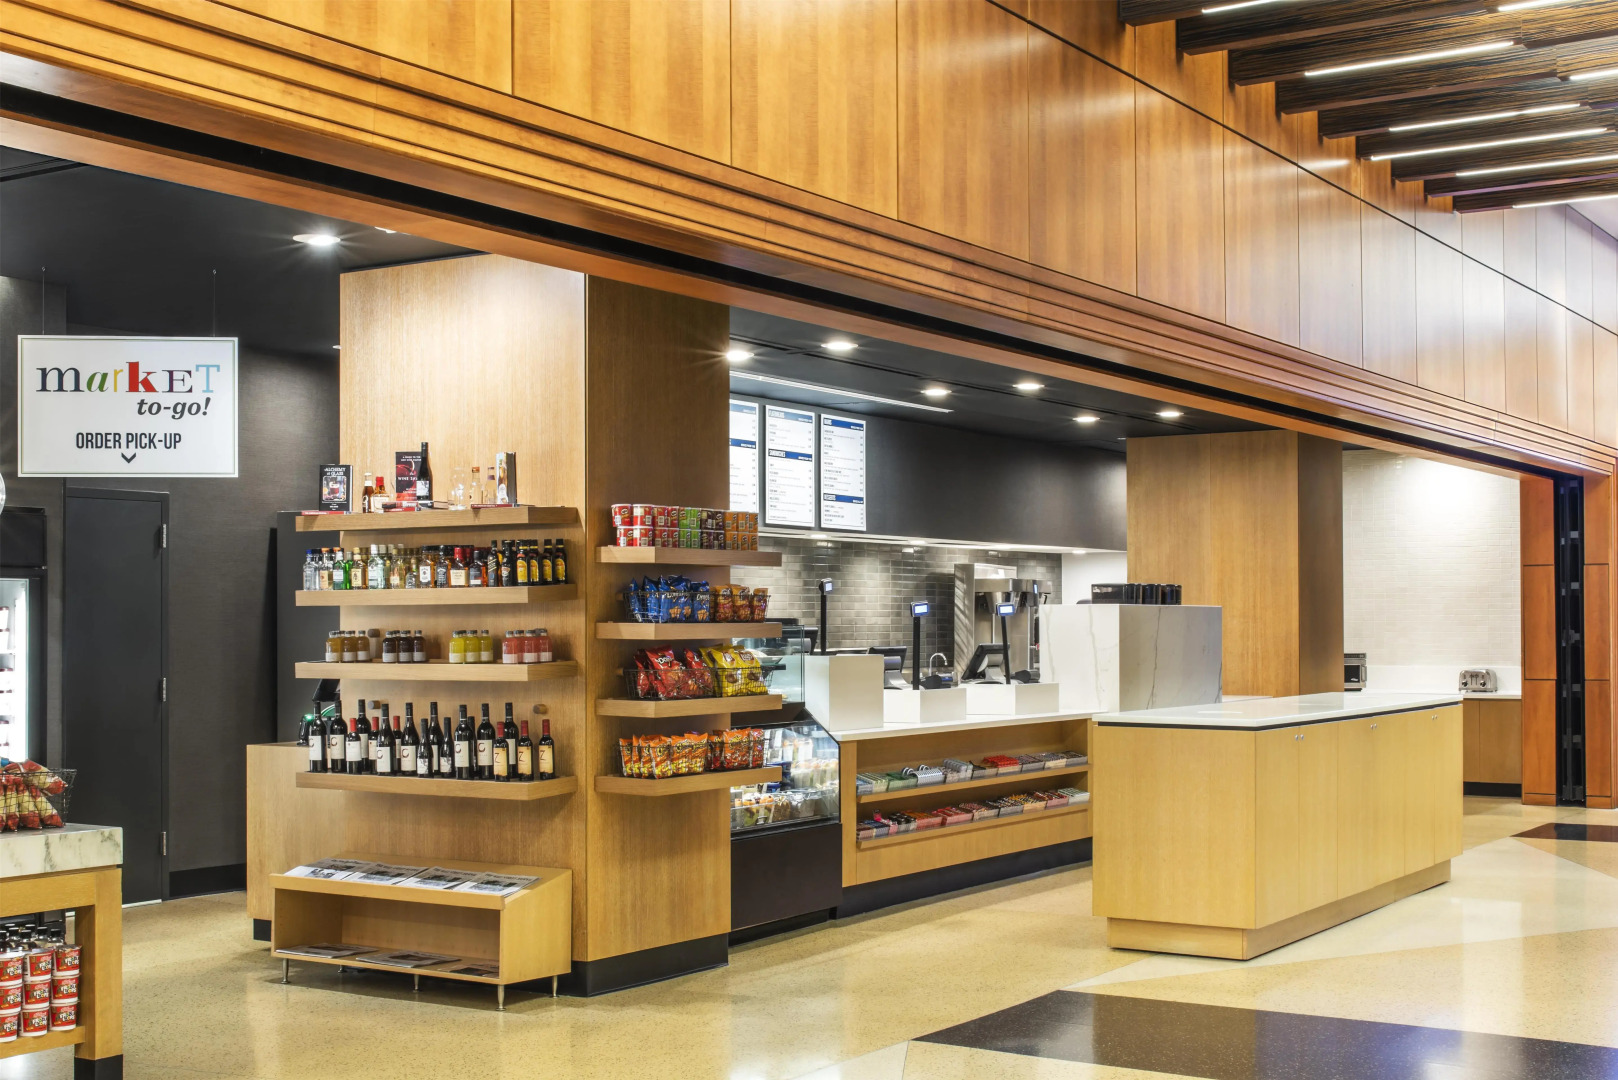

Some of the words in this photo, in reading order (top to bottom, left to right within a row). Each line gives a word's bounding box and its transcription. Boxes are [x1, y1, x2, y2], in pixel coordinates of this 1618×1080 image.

[137, 397, 211, 420] to-go!
[76, 432, 122, 449] ORDER
[126, 432, 181, 450] PICK-UP
